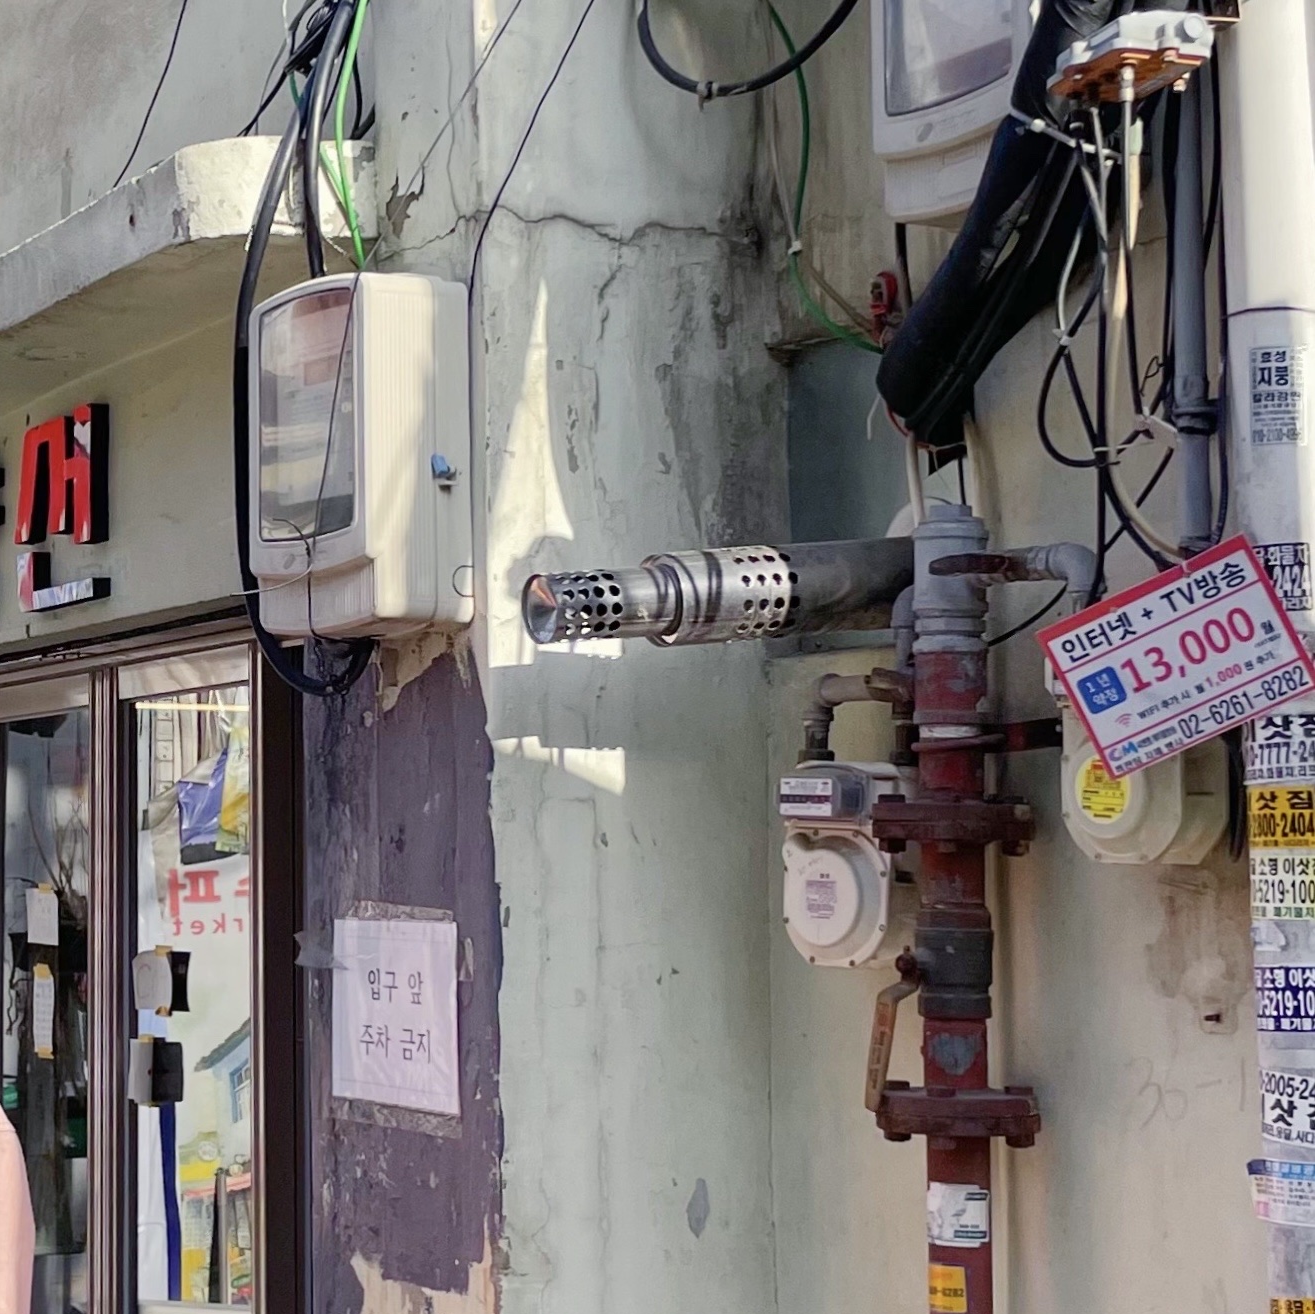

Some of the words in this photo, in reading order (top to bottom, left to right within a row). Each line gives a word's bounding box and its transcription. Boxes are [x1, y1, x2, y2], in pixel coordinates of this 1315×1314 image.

[1258, 366, 1288, 386] 지붕
[1061, 612, 1137, 663] 인터넷
[1160, 561, 1247, 613] TV방송
[1120, 607, 1255, 694] 13,000
[1093, 686, 1118, 706] 약정
[1137, 703, 1160, 720] WIFI
[1178, 666, 1309, 739] 02-6261-8282
[1283, 857, 1315, 876] 이삿
[368, 968, 398, 1003] 입구
[408, 972, 424, 1005] 앞
[360, 1024, 391, 1058] 주차
[400, 1029, 431, 1064] 금지
